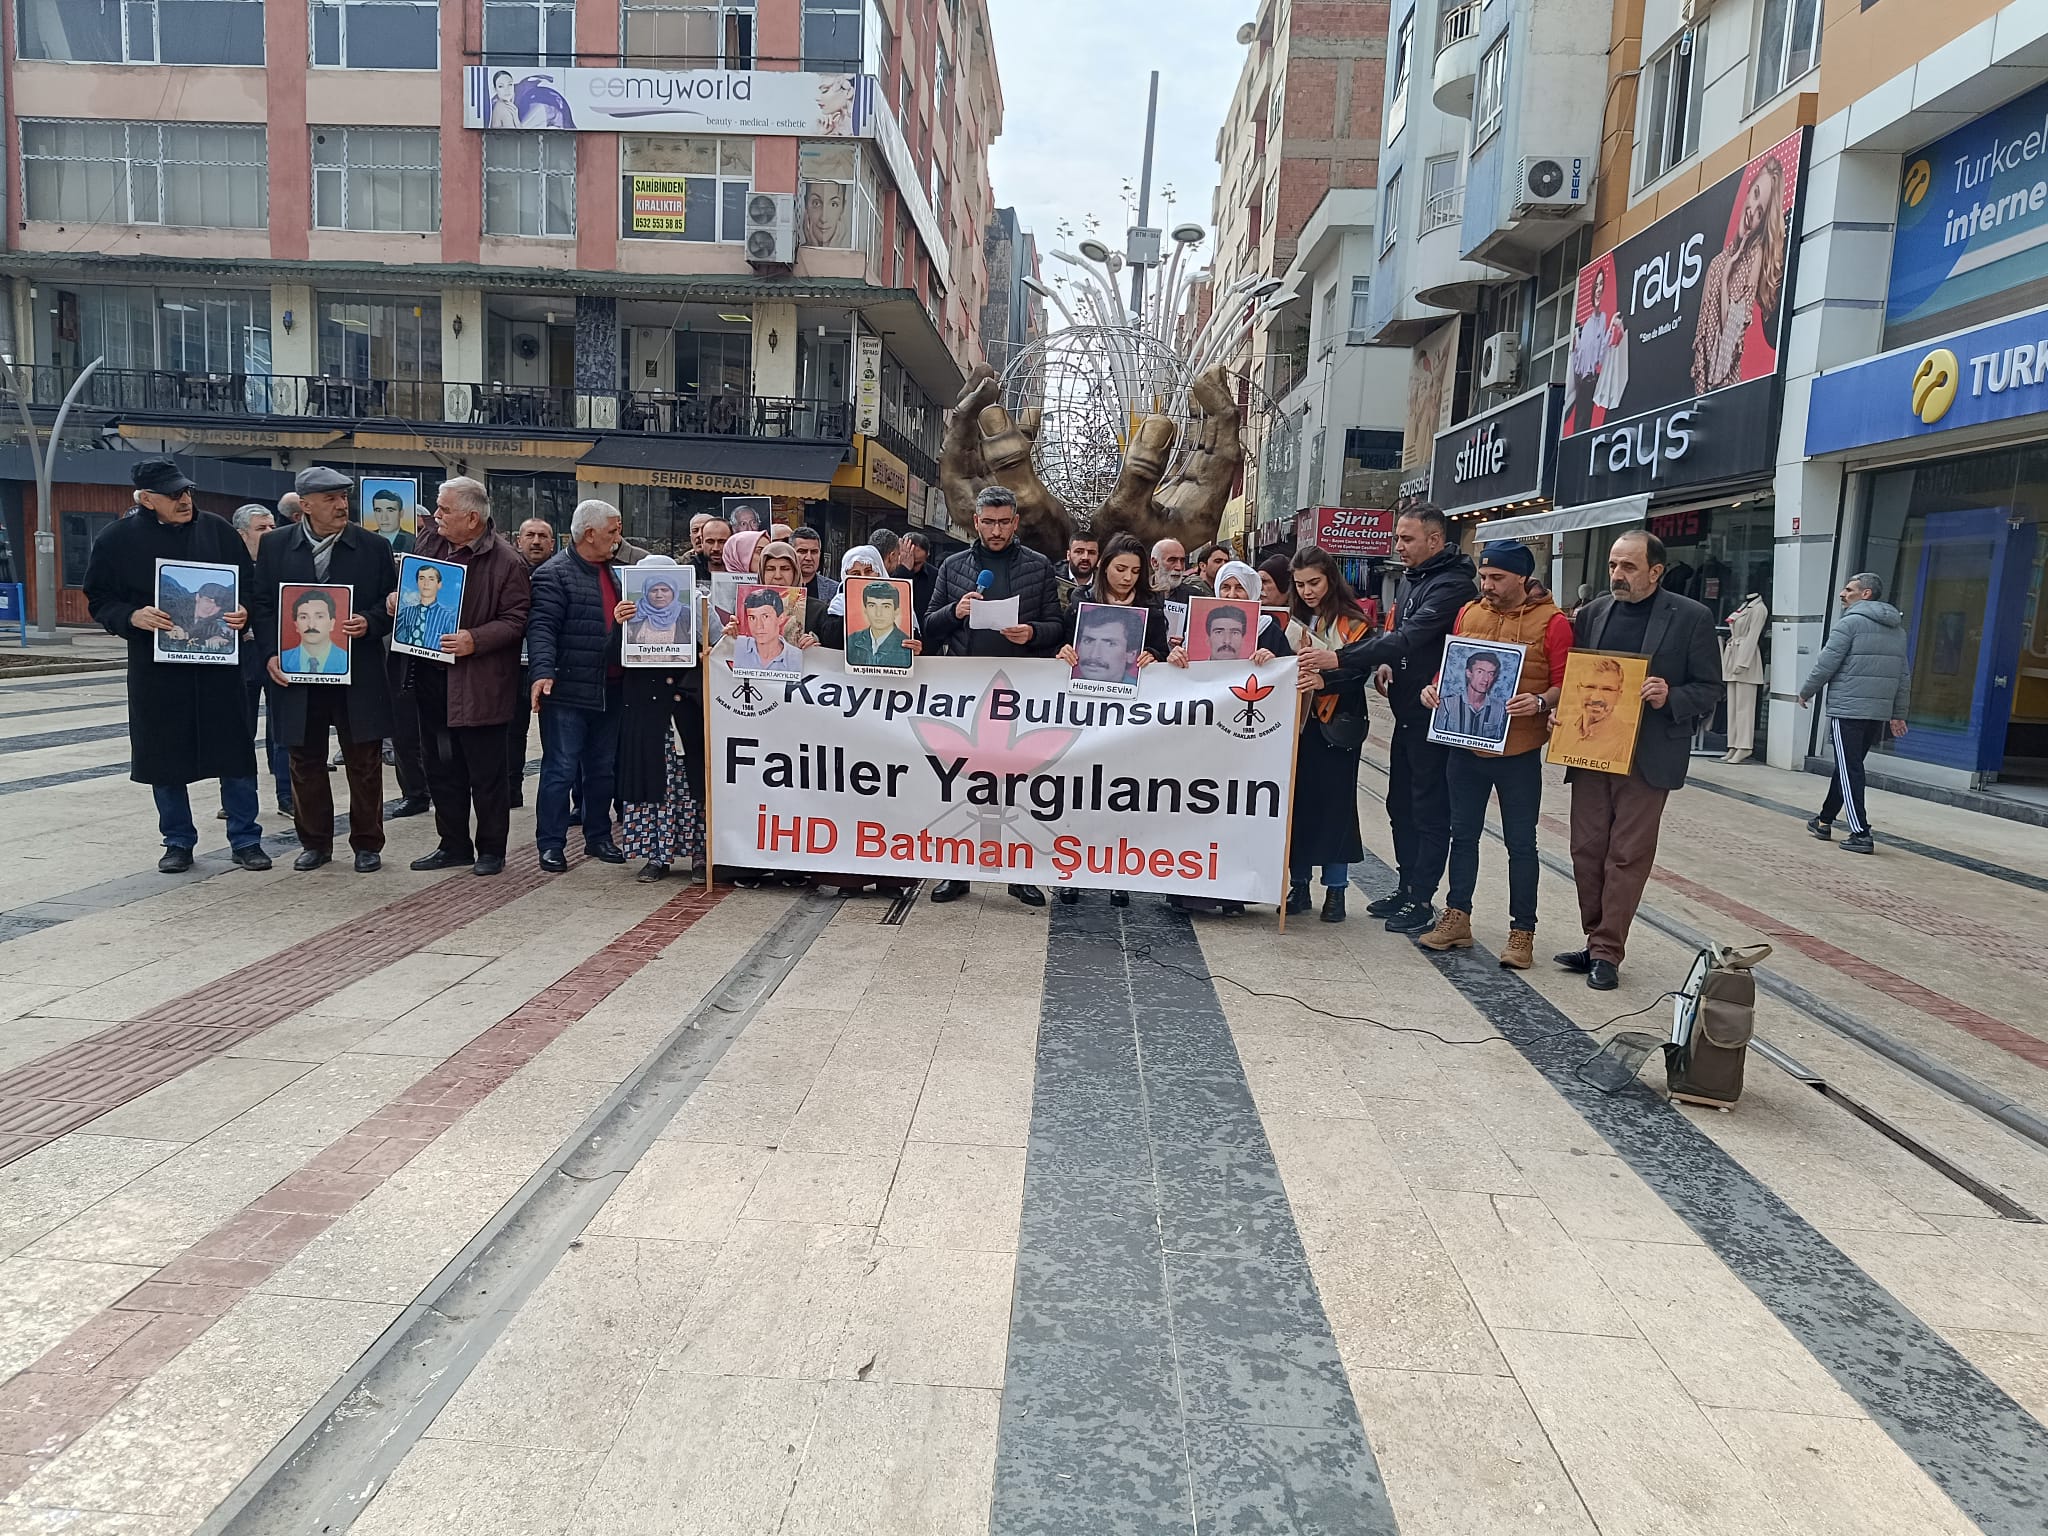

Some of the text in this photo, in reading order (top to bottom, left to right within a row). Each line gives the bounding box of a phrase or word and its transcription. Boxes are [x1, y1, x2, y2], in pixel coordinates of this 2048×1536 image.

[589, 74, 751, 105] esmyworld
[706, 117, 806, 128] beauty medical esthetic
[635, 178, 683, 193] SAHİBİNDEN
[1571, 158, 1581, 199] BEKO
[1943, 181, 2047, 248] interne
[635, 218, 651, 228] 0532
[652, 219, 664, 229] 553
[674, 219, 683, 230] 85
[1630, 232, 1704, 316] rays
[224, 430, 279, 443] SOFRASI
[424, 436, 523, 452] ŞEHİR SOFRASI
[1454, 422, 1504, 484] stilife
[1589, 410, 1692, 480] rays
[650, 471, 756, 491] ŞEHİR SOFRASI
[1332, 511, 1379, 527] Şirin
[1322, 526, 1387, 539] Collection
[410, 647, 429, 657] AYDIN
[638, 645, 680, 654] Taybet Ana
[733, 669, 758, 677] MEHMET
[1072, 682, 1132, 695] Hüseyin SEVİM
[784, 674, 1215, 727] Kayıplar Bulunsun
[1435, 734, 1495, 749] Mehmet ORHAN
[1562, 755, 1588, 767] TAHİR
[726, 737, 1281, 821] Failler Yargılansın
[757, 804, 1219, 881] İHD Batman Şubesi
